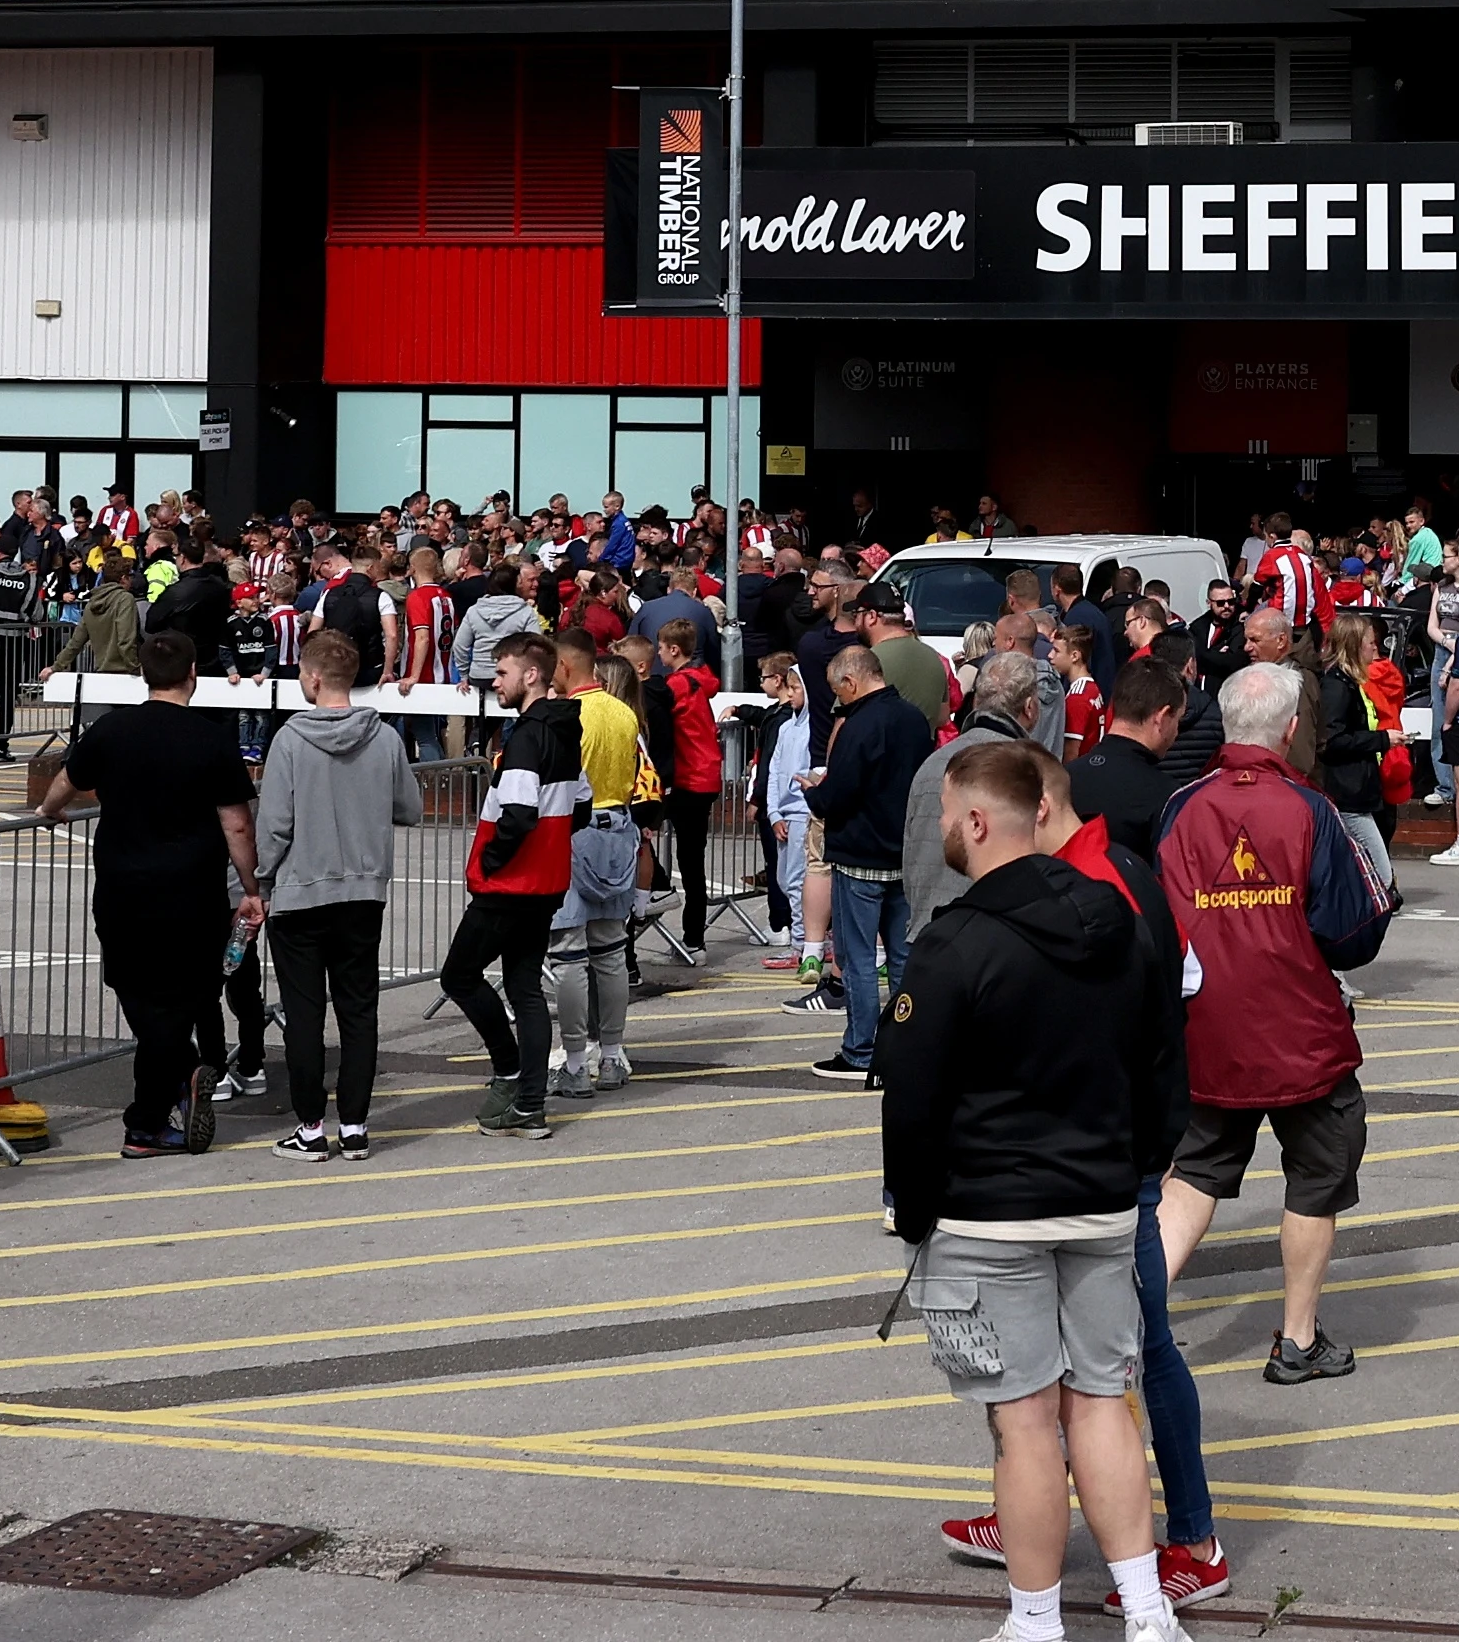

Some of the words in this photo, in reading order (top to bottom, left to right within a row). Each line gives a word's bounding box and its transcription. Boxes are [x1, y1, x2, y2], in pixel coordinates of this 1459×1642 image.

[658, 155, 682, 271] TIMBER
[682, 155, 701, 272] NATIONAL
[721, 195, 839, 253] nold
[840, 198, 966, 254] Laver
[657, 272, 700, 285] GROUP
[877, 361, 956, 373] PLATINUM
[1234, 363, 1309, 375] PLAYERS
[877, 376, 925, 388] SUITE
[1234, 378, 1318, 390] ENTRANCE
